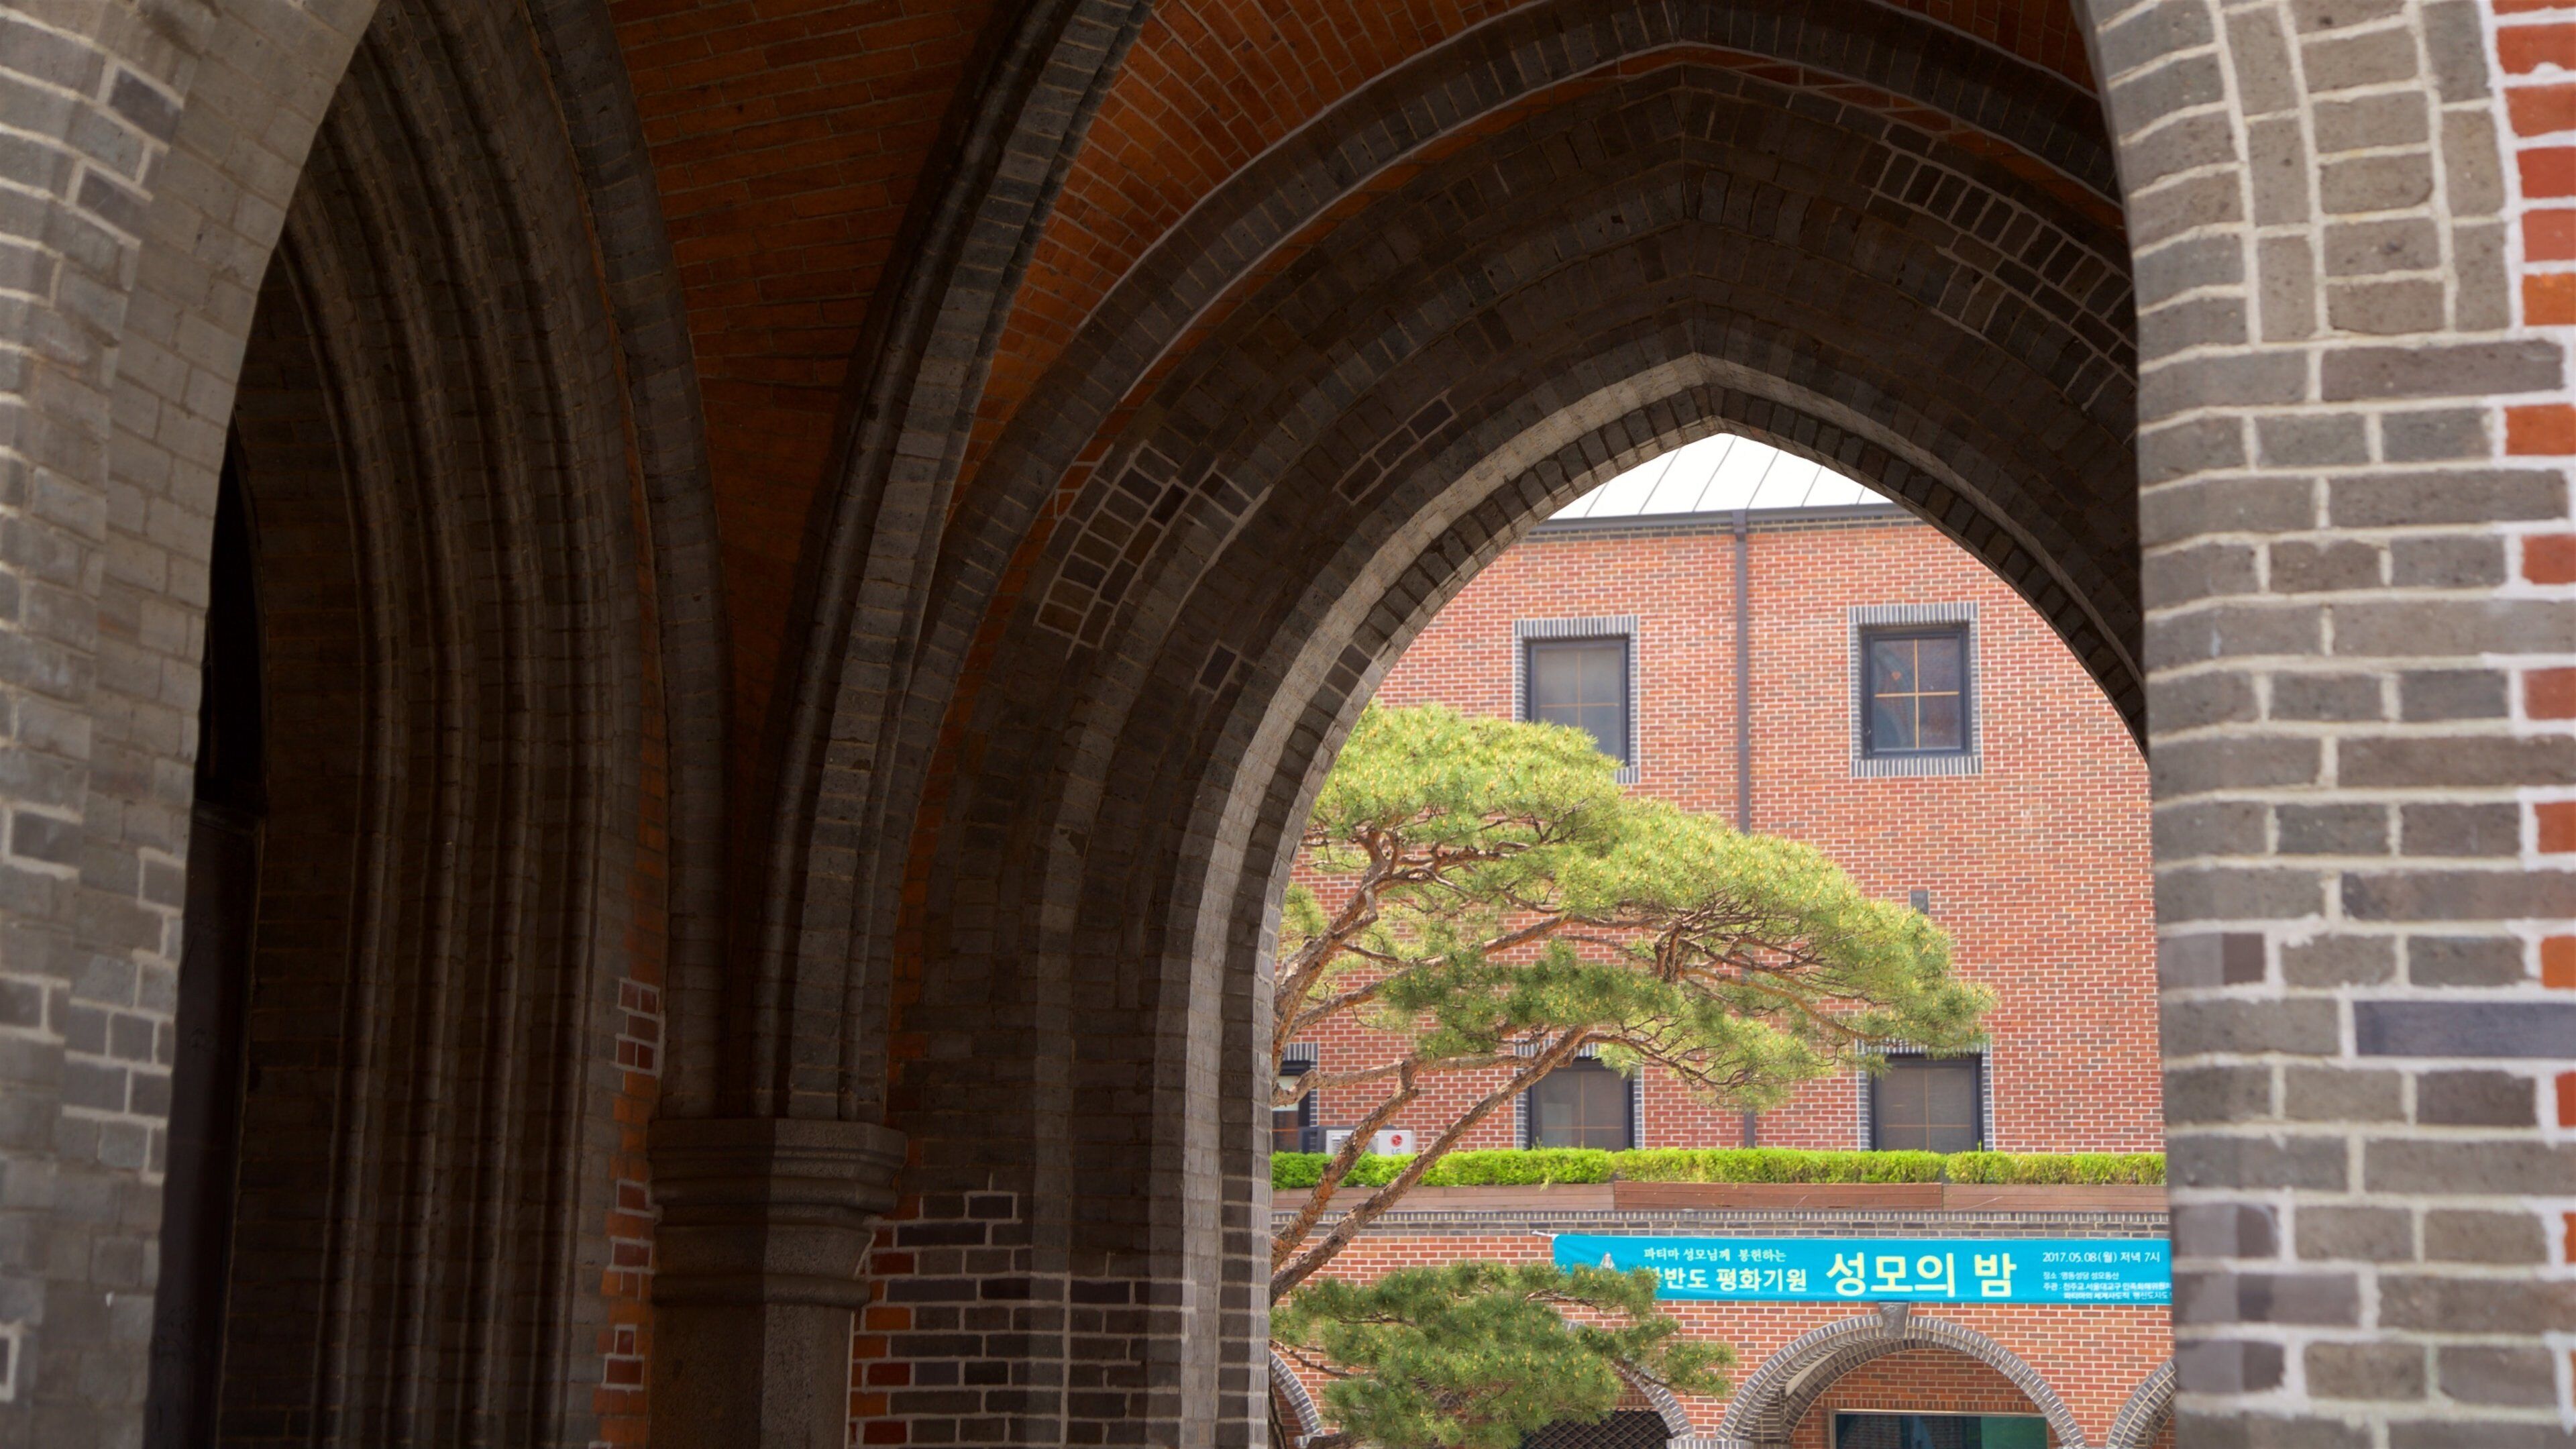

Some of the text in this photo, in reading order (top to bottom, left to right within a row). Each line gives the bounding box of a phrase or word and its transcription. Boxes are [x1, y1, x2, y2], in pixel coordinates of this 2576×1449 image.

[1644, 1248, 1787, 1263] 파티마 성모님께 봉헌하는
[2043, 1252, 2160, 1263] 2017.05.08(월) 저녁 7시
[1716, 1268, 1807, 1292] 평화기원
[1826, 1252, 2017, 1298] 성모의 밤
